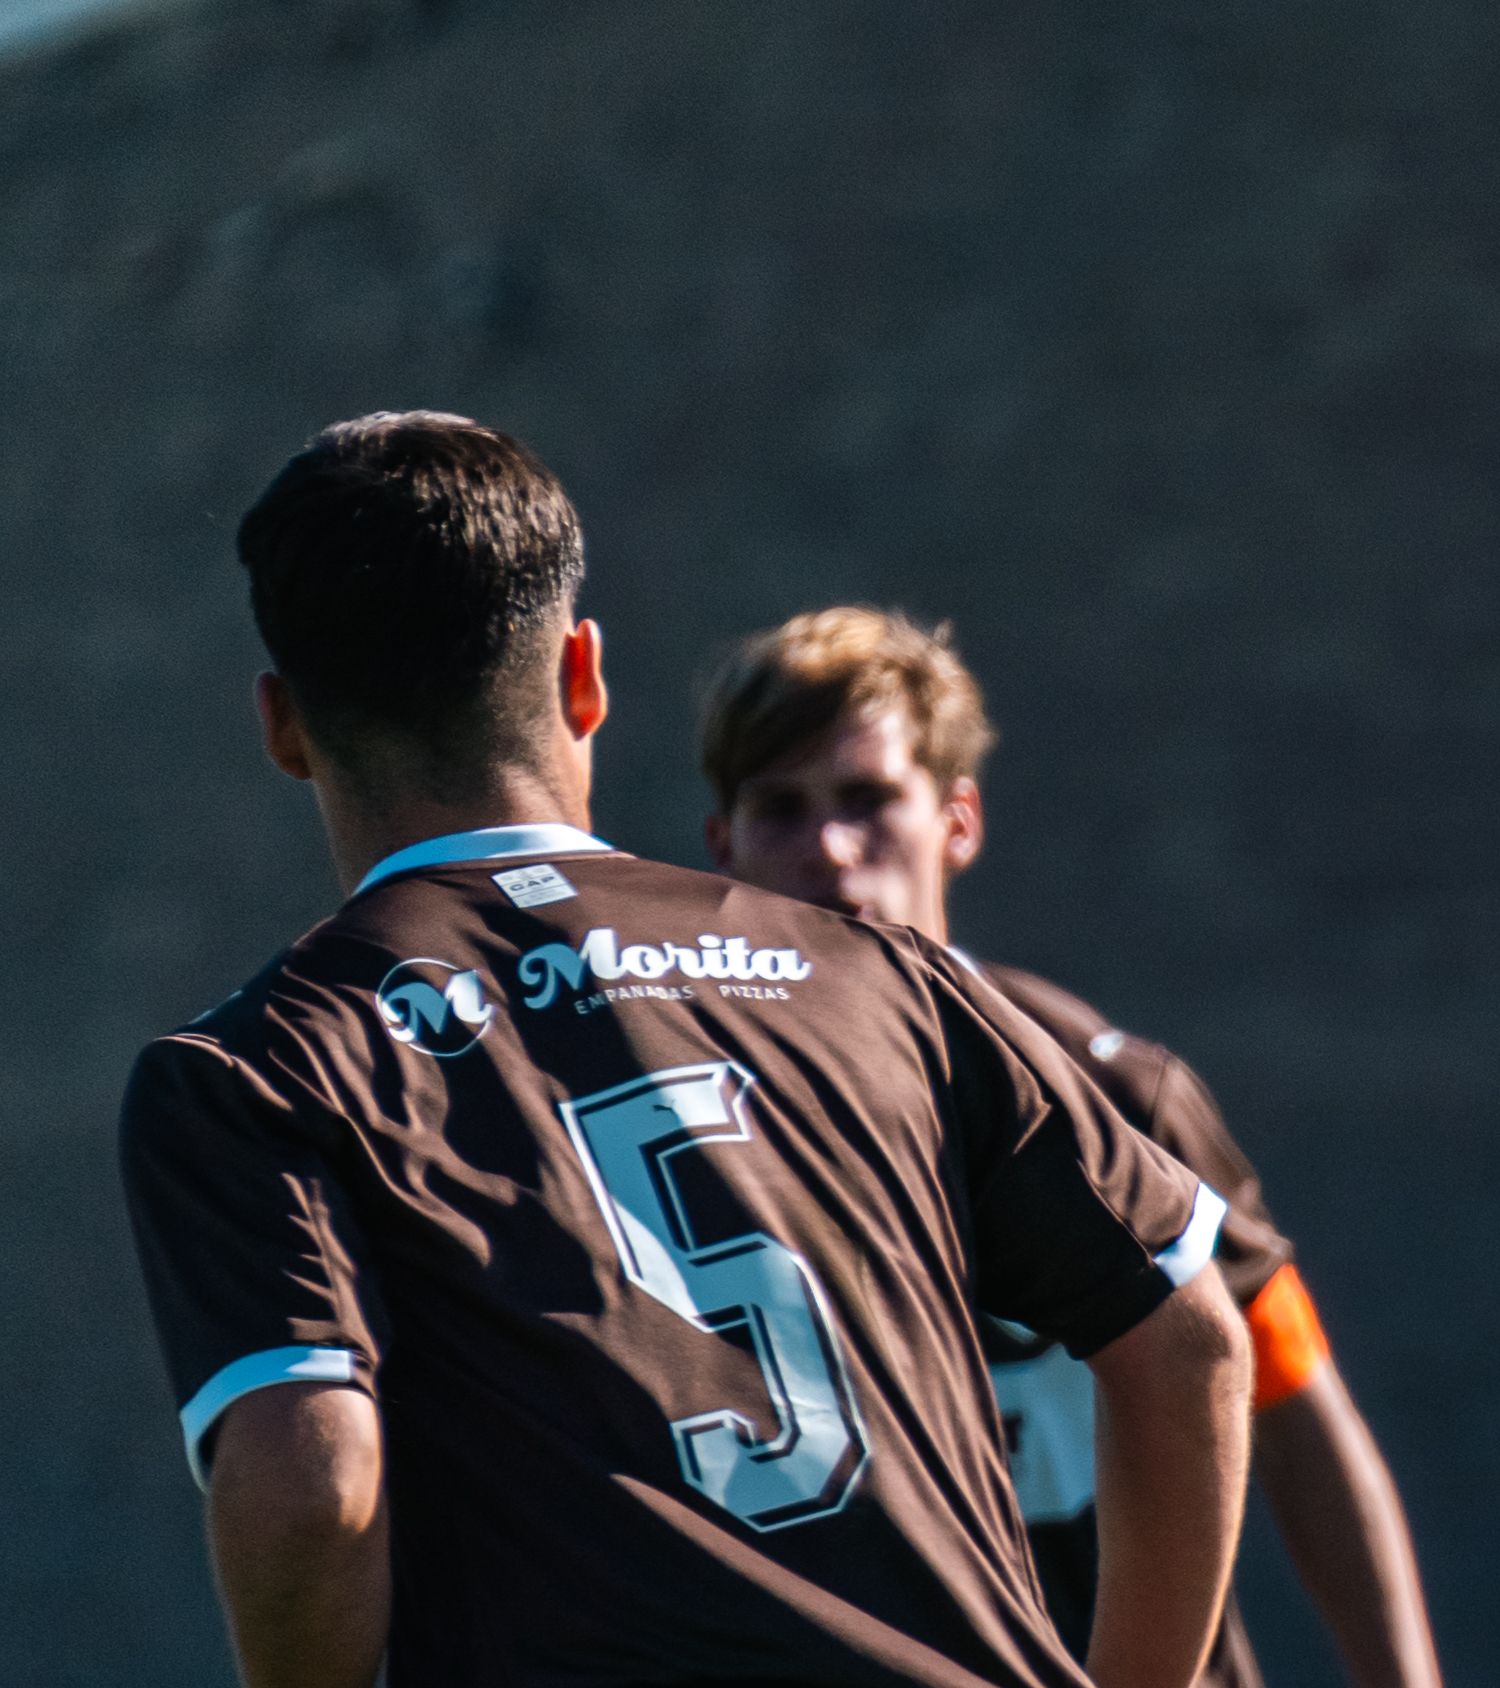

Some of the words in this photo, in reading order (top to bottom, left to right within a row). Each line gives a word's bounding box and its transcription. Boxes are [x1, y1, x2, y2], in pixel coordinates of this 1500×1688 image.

[518, 927, 812, 1010] Morita
[573, 984, 695, 1015] EMPANADAS
[718, 984, 790, 1001] PIZZAS
[560, 1060, 871, 1532] 5
